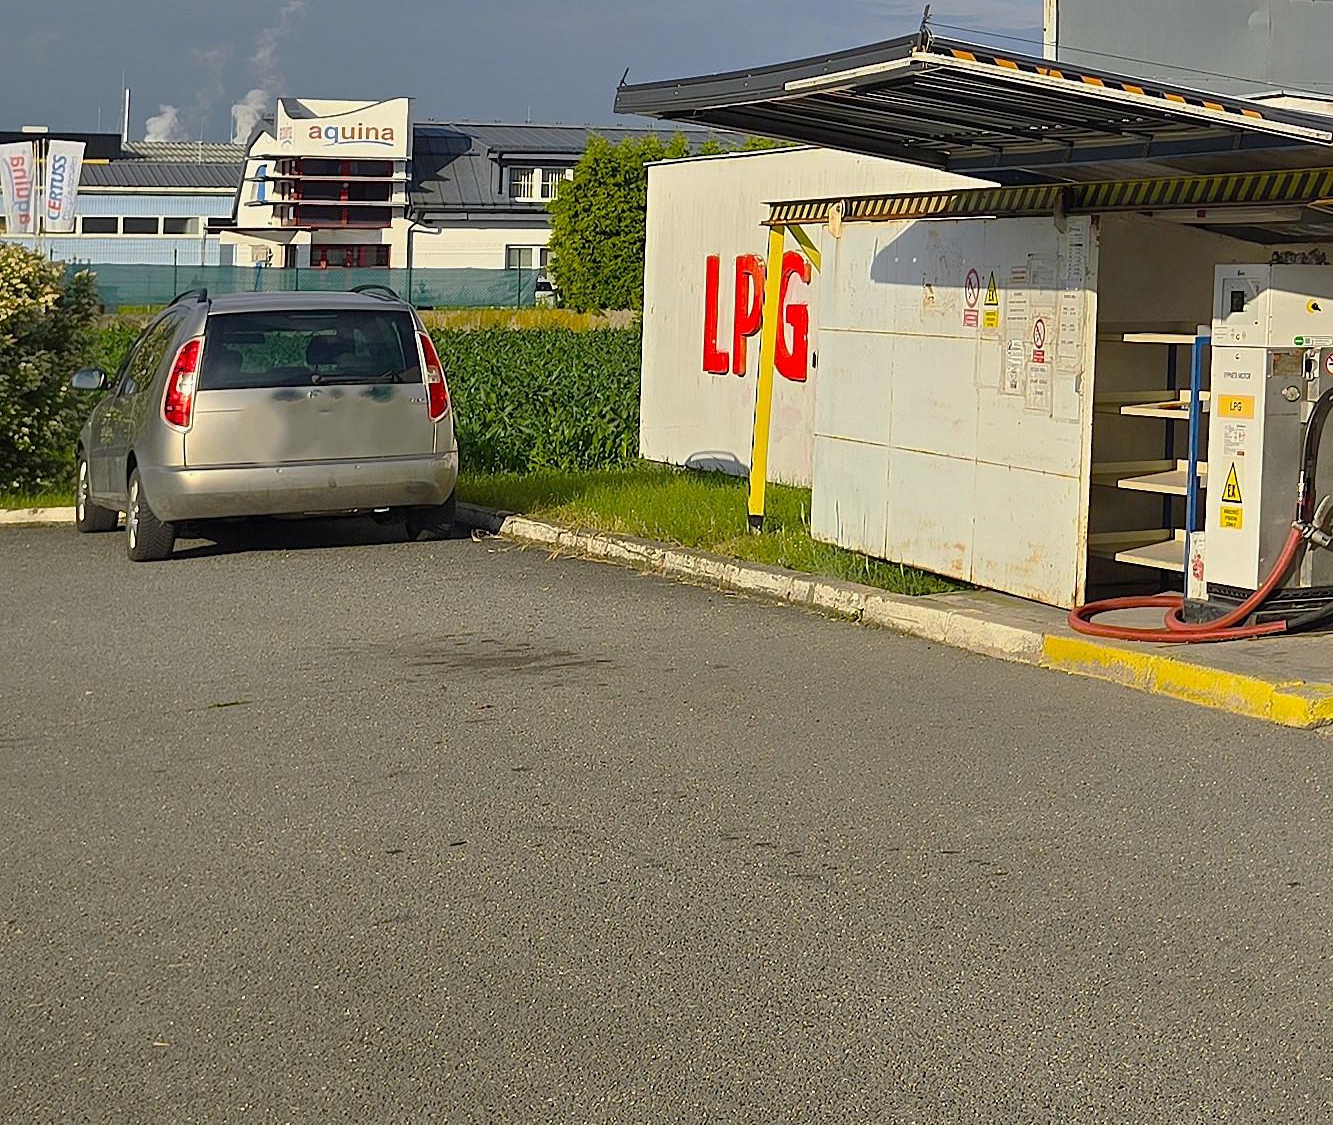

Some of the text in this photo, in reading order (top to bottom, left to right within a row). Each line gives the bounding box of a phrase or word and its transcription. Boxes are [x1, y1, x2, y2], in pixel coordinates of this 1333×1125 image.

[308, 123, 394, 143] aquina
[10, 155, 32, 225] aquina
[47, 154, 67, 221] CERTUSS
[703, 250, 812, 383] LPG
[1230, 401, 1242, 411] LPG
[1227, 483, 1236, 498] EX
